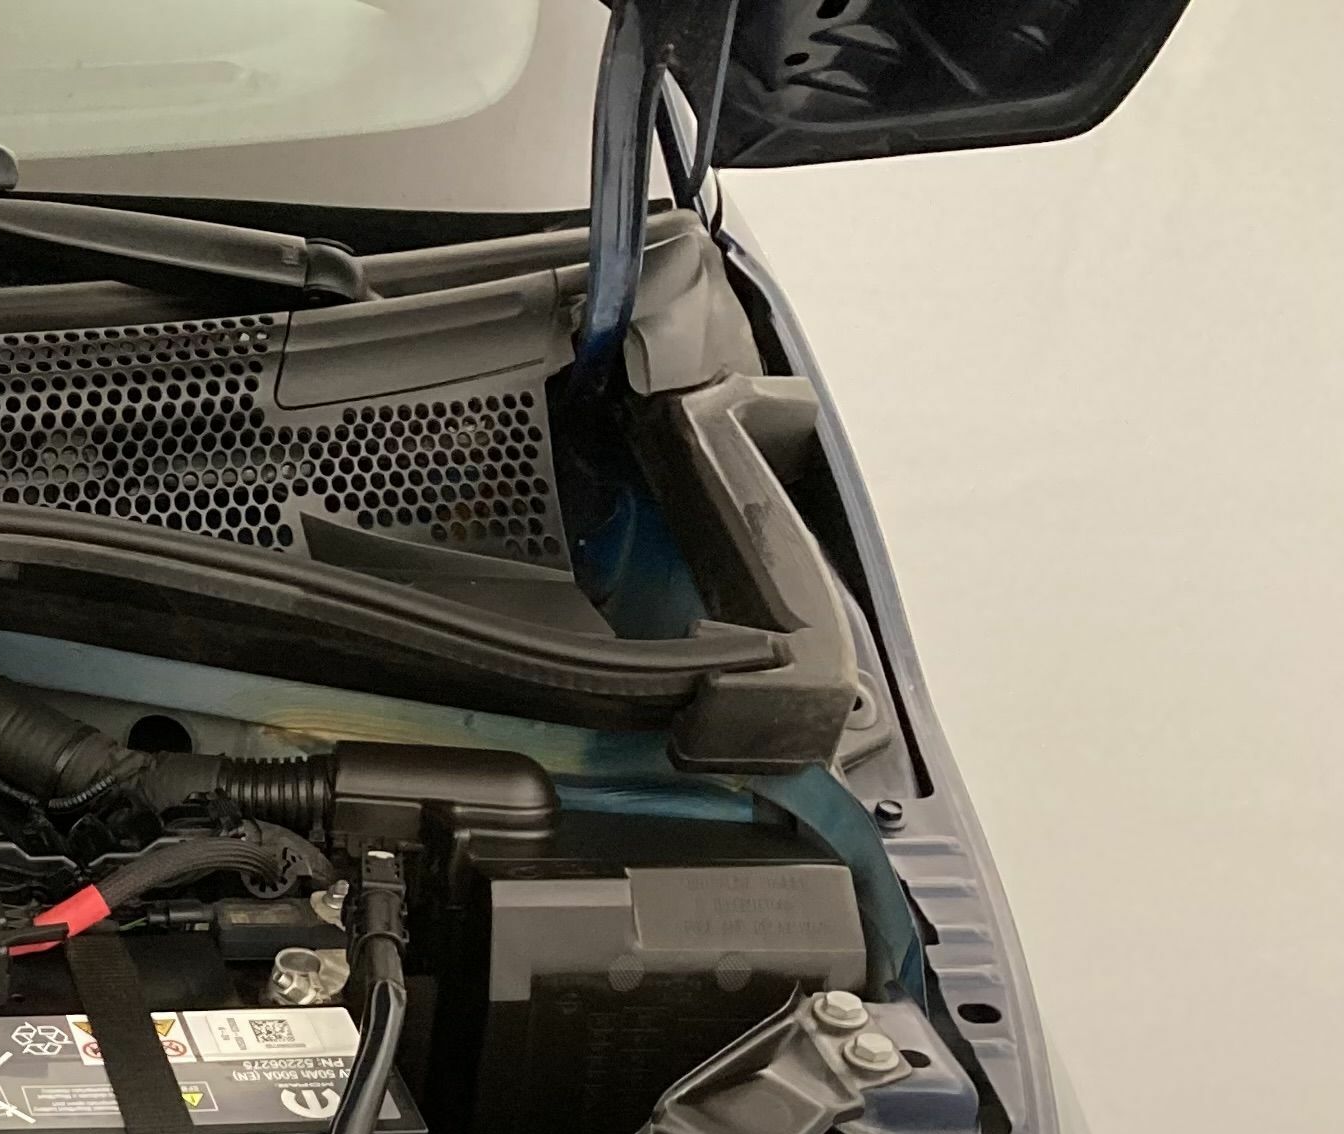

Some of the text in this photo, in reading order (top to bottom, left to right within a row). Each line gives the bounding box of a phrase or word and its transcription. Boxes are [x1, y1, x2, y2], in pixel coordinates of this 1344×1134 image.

[242, 1057, 345, 1070] PN: 52206275
[232, 1070, 261, 1082] (EN)
[263, 1070, 299, 1081] 500A
[300, 1069, 336, 1080] 50Ah
